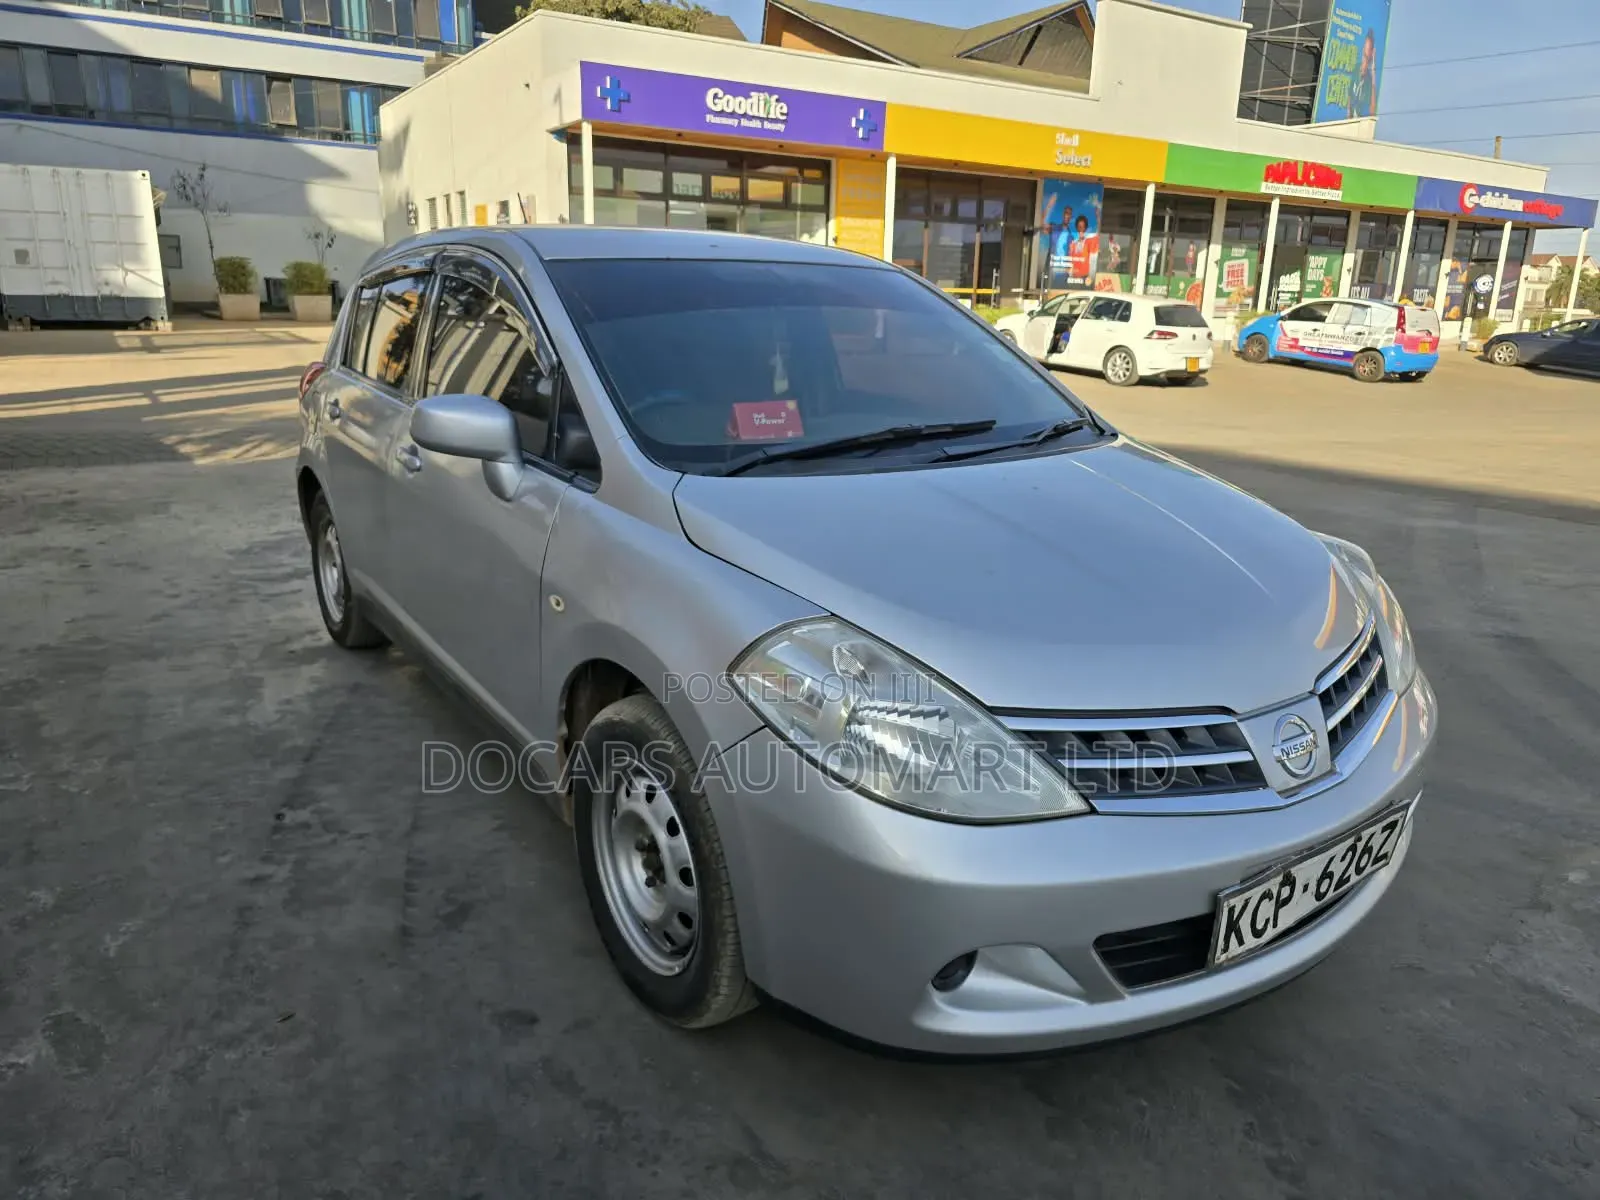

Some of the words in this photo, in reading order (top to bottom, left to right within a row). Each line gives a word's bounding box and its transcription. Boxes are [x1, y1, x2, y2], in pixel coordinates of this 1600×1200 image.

[706, 88, 788, 120] Goodlife
[1056, 149, 1092, 167] Select
[1227, 268, 1244, 280] FREE
[1280, 733, 1318, 758] NISSAN
